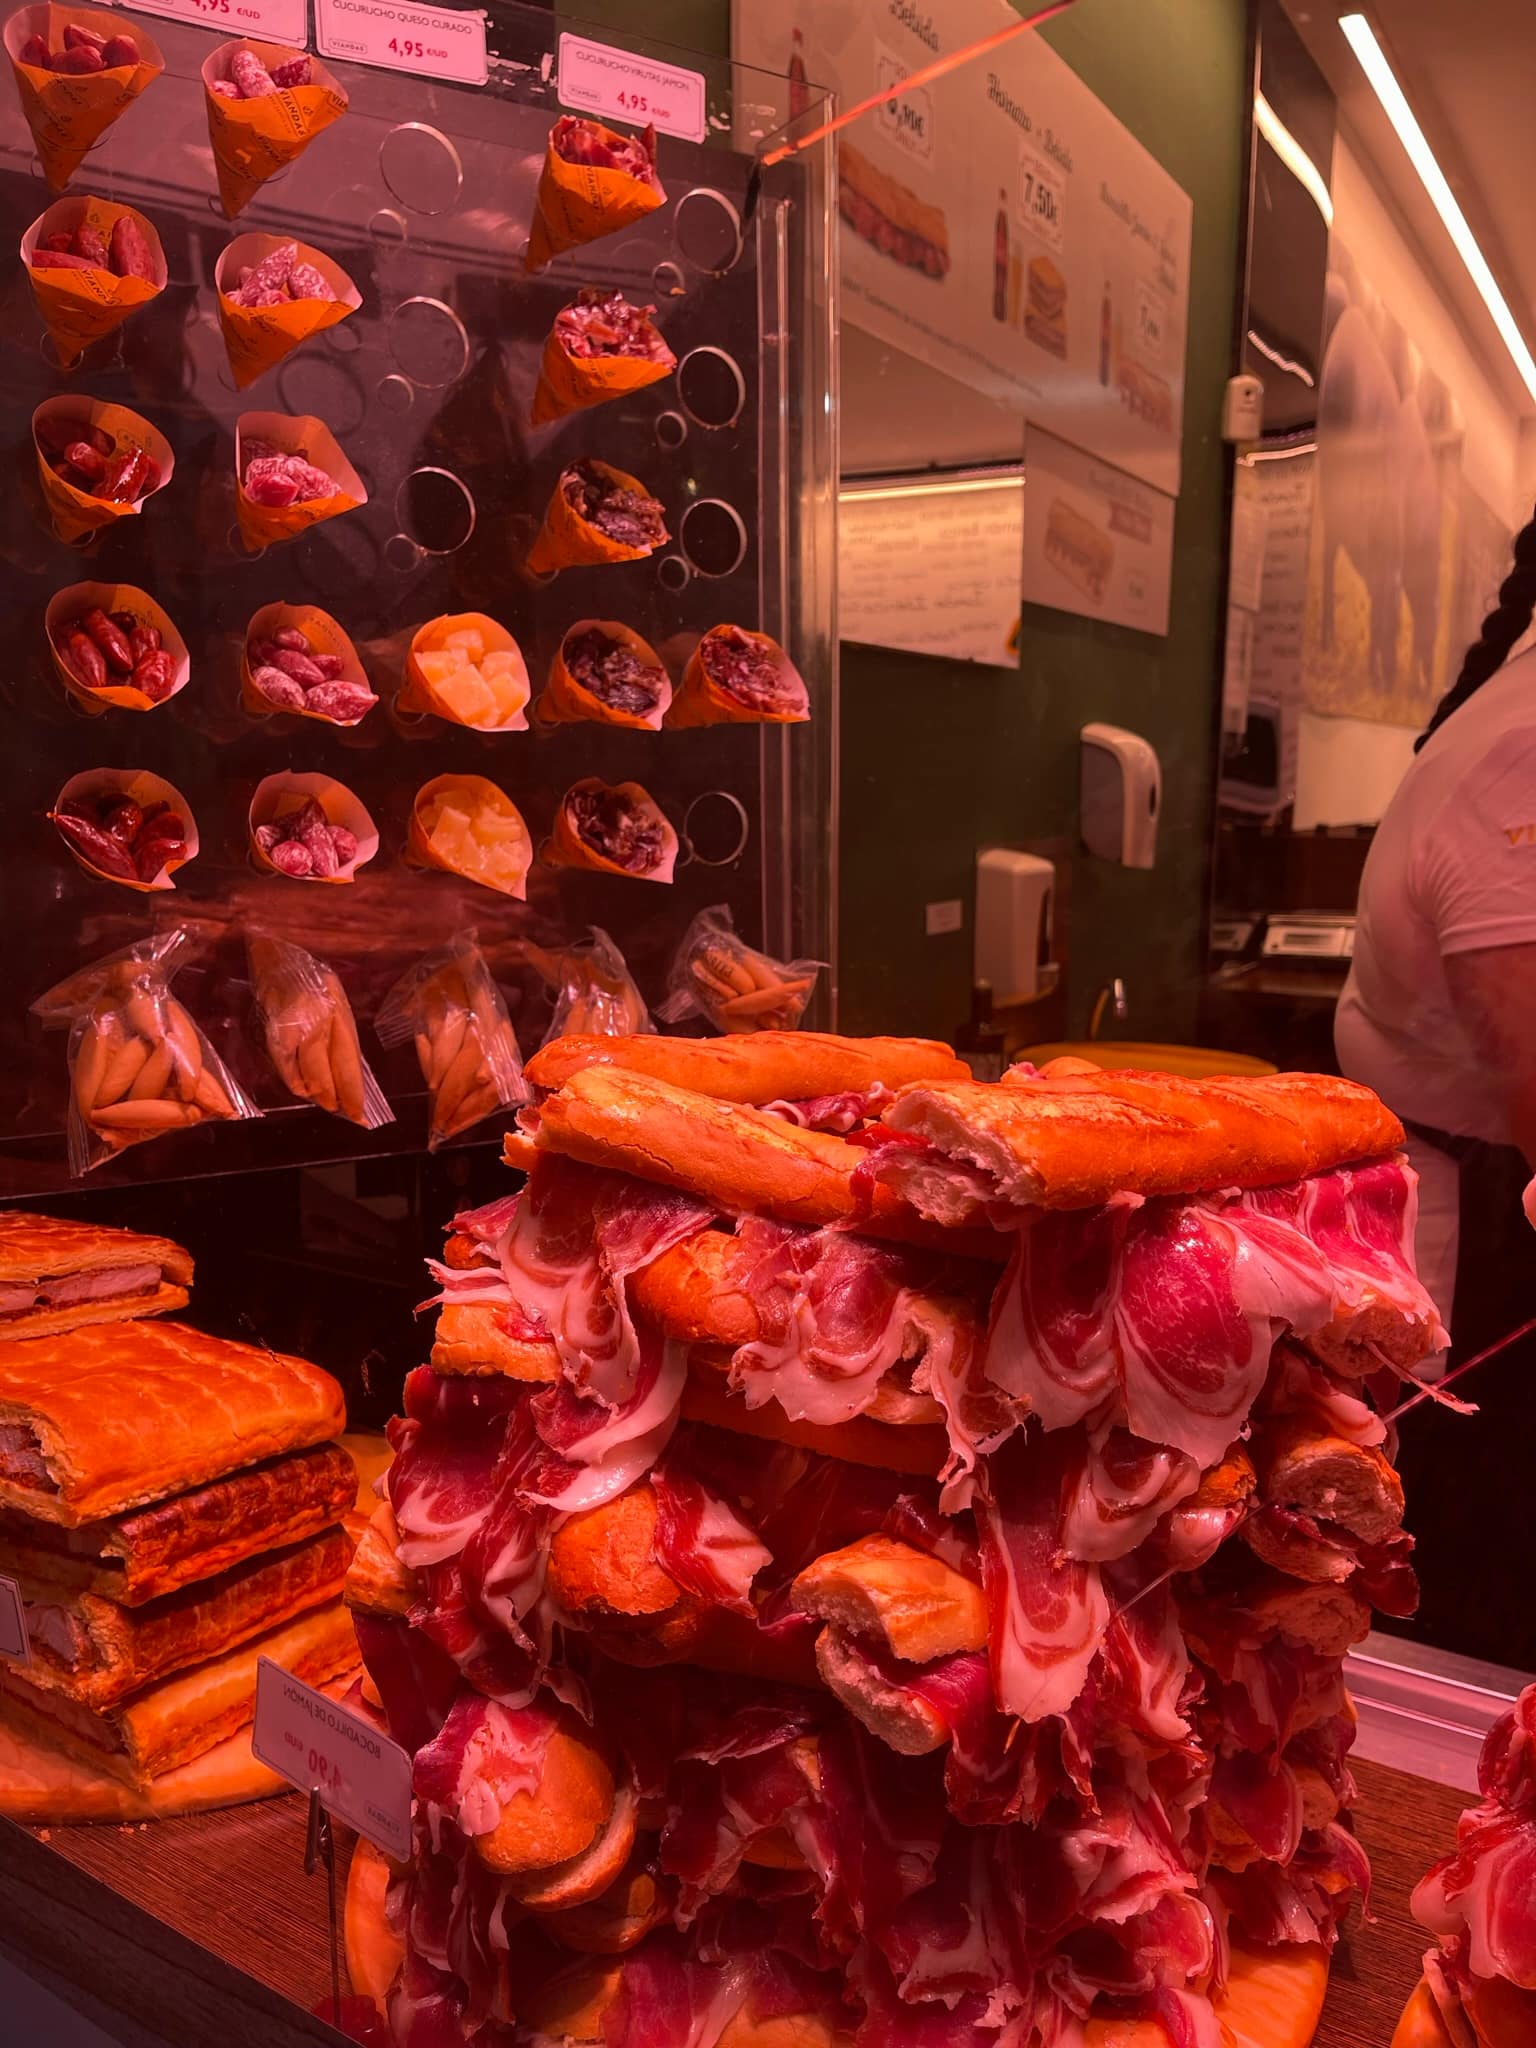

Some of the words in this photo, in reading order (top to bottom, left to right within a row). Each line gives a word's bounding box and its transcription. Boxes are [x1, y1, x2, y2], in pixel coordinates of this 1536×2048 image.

[236, 8, 261, 20] €/UD
[333, 0, 396, 20] CUCURUCHO
[397, 12, 430, 26] QUESO
[431, 19, 473, 35] CURADO
[332, 41, 365, 52] VIANDAS
[388, 37, 424, 58] 4,95
[617, 91, 648, 111] 4,95
[280, 90, 306, 136] VIANDAS
